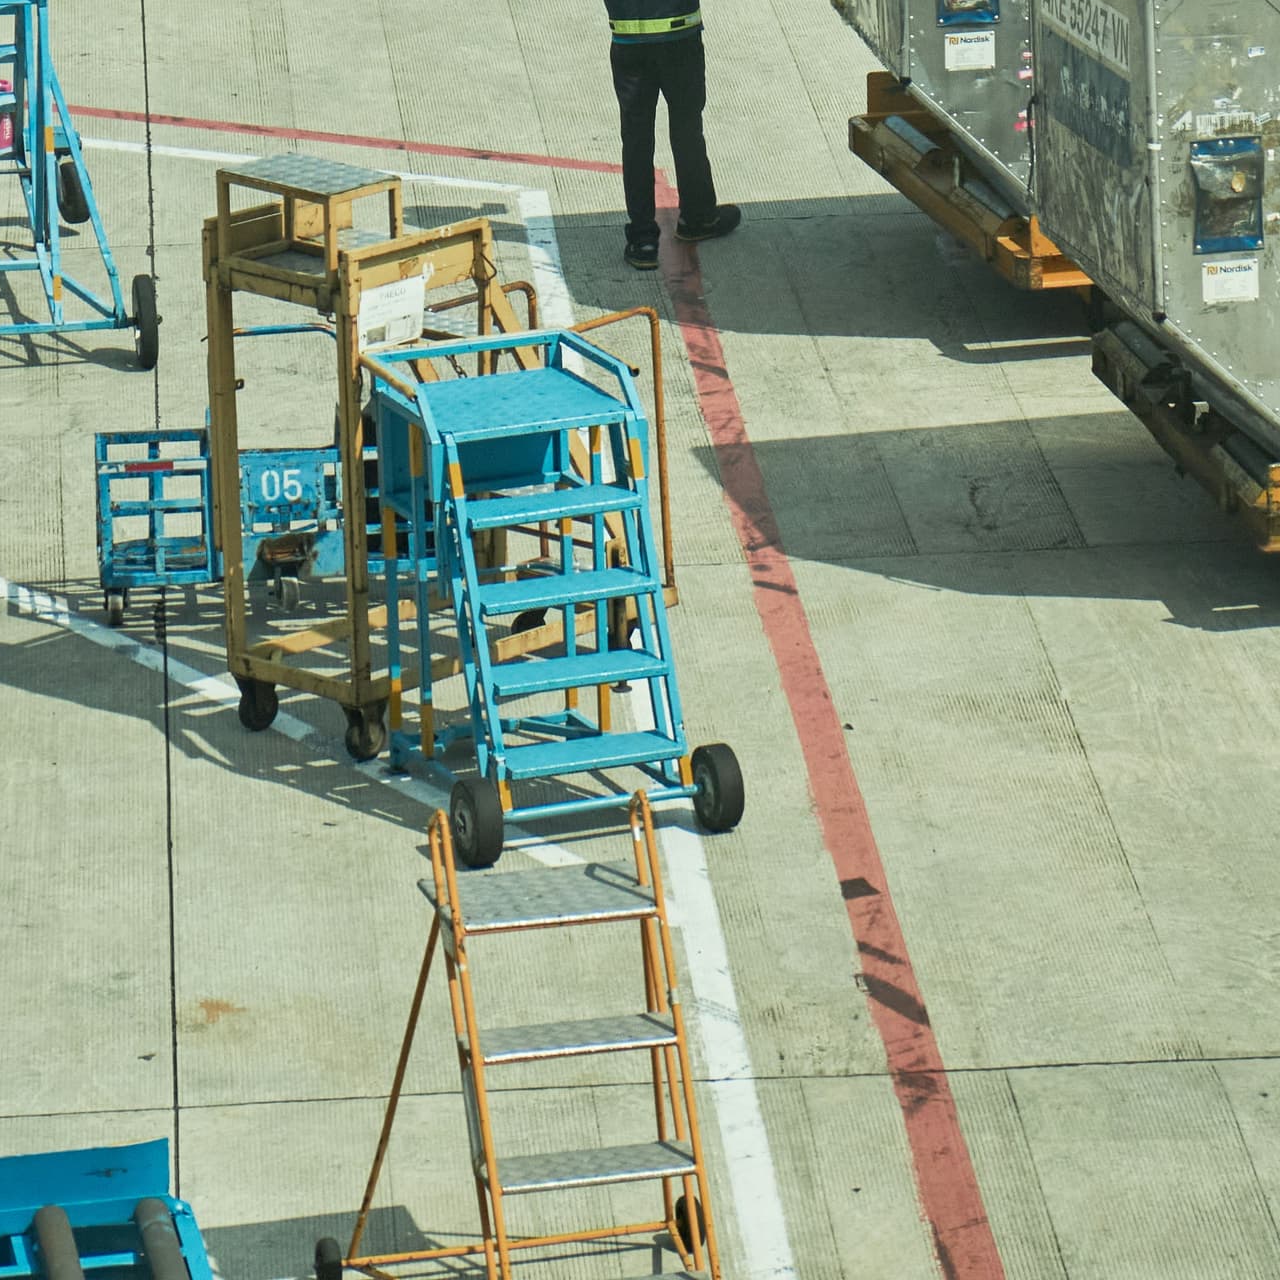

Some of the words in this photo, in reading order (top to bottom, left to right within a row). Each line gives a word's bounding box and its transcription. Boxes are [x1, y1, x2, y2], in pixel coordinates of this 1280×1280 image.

[1111, 13, 1130, 66] VN
[1220, 264, 1254, 273] Nordisk
[261, 469, 302, 501] 05
